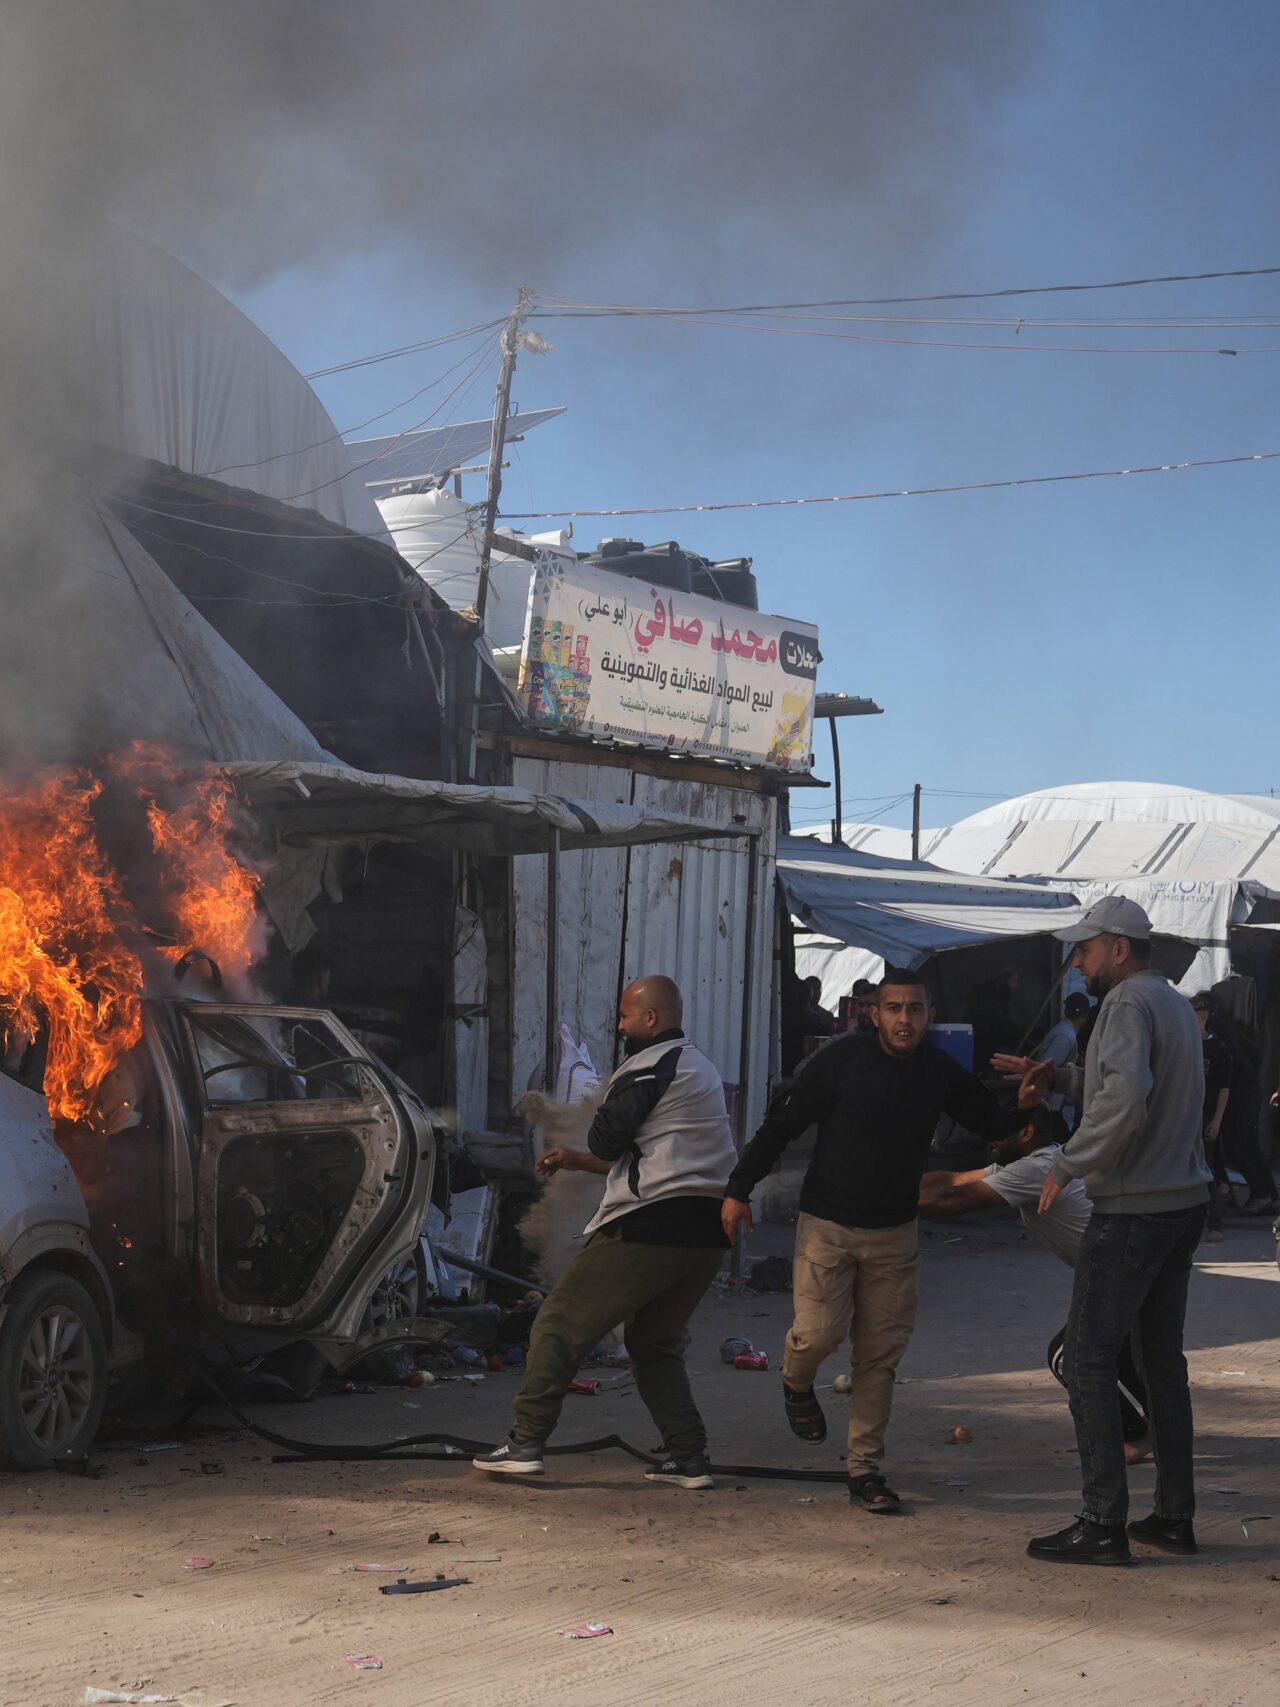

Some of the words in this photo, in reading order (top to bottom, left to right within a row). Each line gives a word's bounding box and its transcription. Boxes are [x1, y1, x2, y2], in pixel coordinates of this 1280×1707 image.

[635, 587, 703, 654] صافي
[711, 616, 777, 664] محمد
[601, 651, 667, 690] والتموينية
[670, 667, 715, 694] الغذائية
[717, 679, 750, 705] المواد
[751, 690, 773, 713] لبيع
[1163, 894, 1214, 903] MIGRATION
[1173, 881, 1215, 895] IOM
